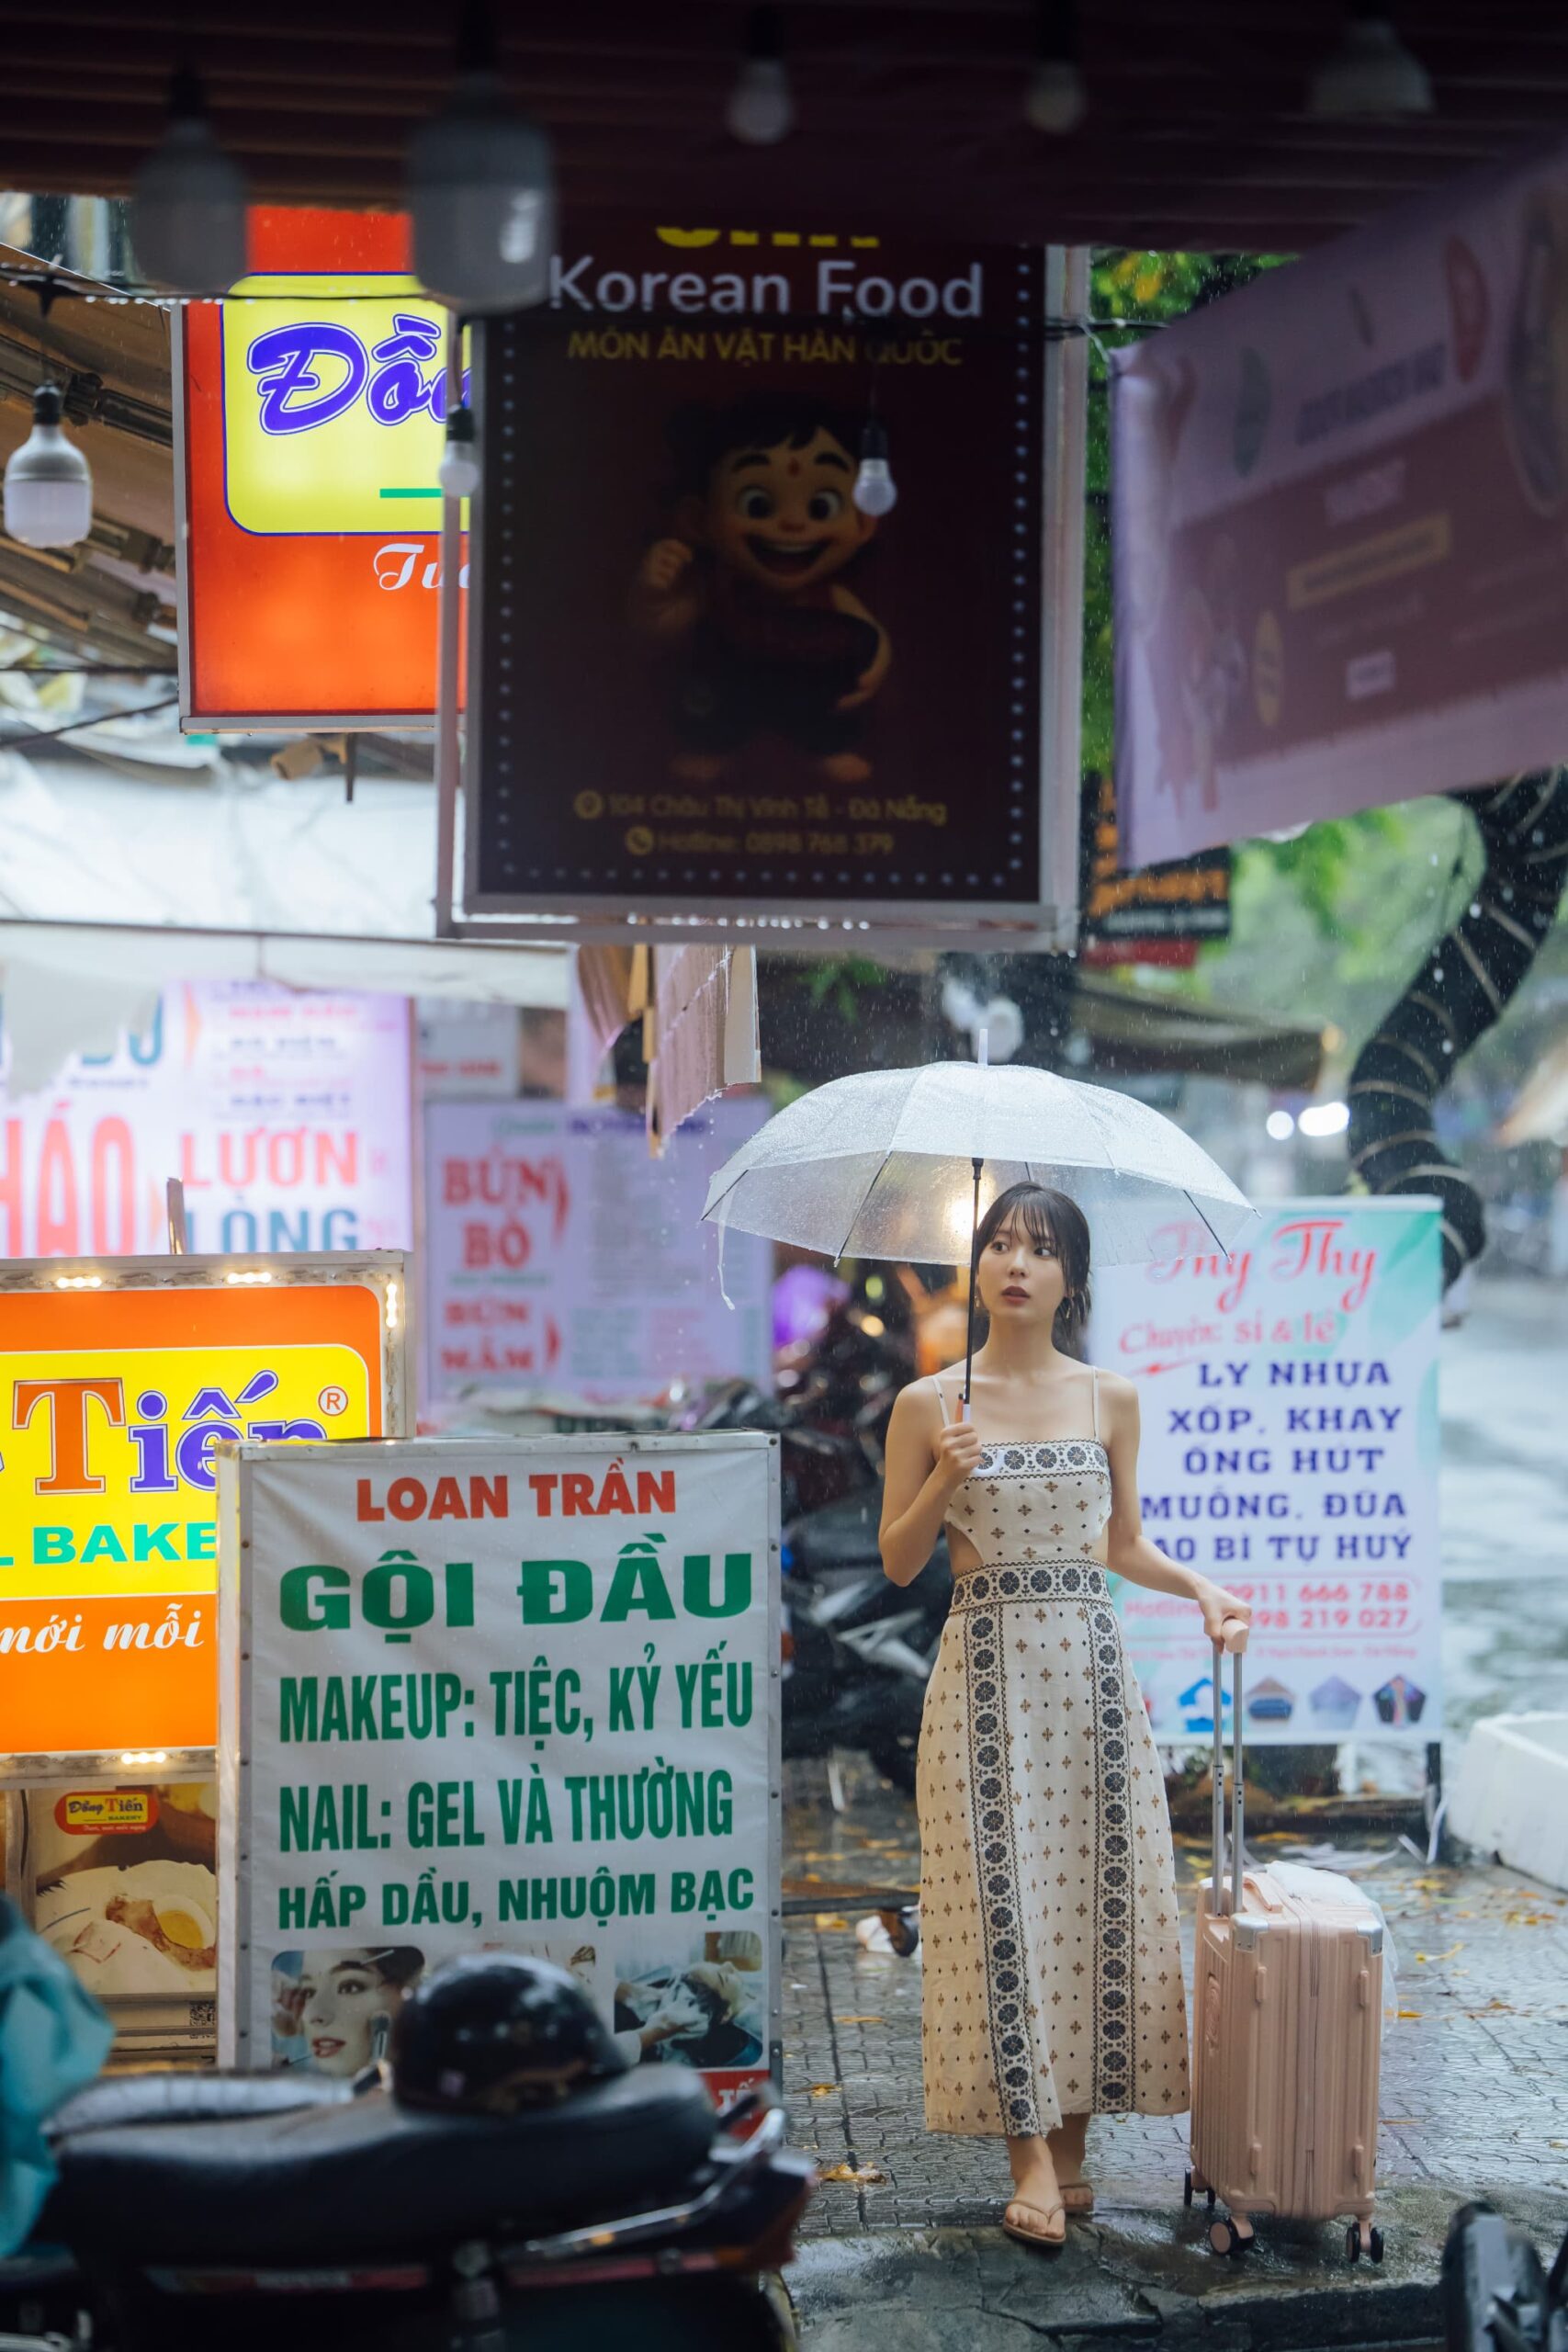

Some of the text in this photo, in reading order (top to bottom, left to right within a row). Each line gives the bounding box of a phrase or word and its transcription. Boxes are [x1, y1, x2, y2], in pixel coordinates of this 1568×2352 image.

[548, 255, 982, 318] Korean Food
[181, 1125, 359, 1188] LƯƠN
[1199, 1362, 1250, 1387] LY
[1287, 1407, 1403, 1433] KHAY
[355, 1456, 677, 1522] LOAN TRẦN
[278, 1532, 752, 1644] GỘI ĐẦU
[1299, 1582, 1350, 1603] 666
[1359, 1582, 1410, 1603] 788
[1300, 1609, 1351, 1629] 219
[1359, 1608, 1411, 1629] 027
[103, 1601, 205, 1651] mỗi
[279, 1640, 753, 1750] MAKEUP: TIỆC, KỶ YẾU
[279, 1756, 734, 1853] NAIL: GEL VÀ THƯỜNG
[278, 1866, 754, 1930] HẤP DẦU, NHUỘM BẠC
